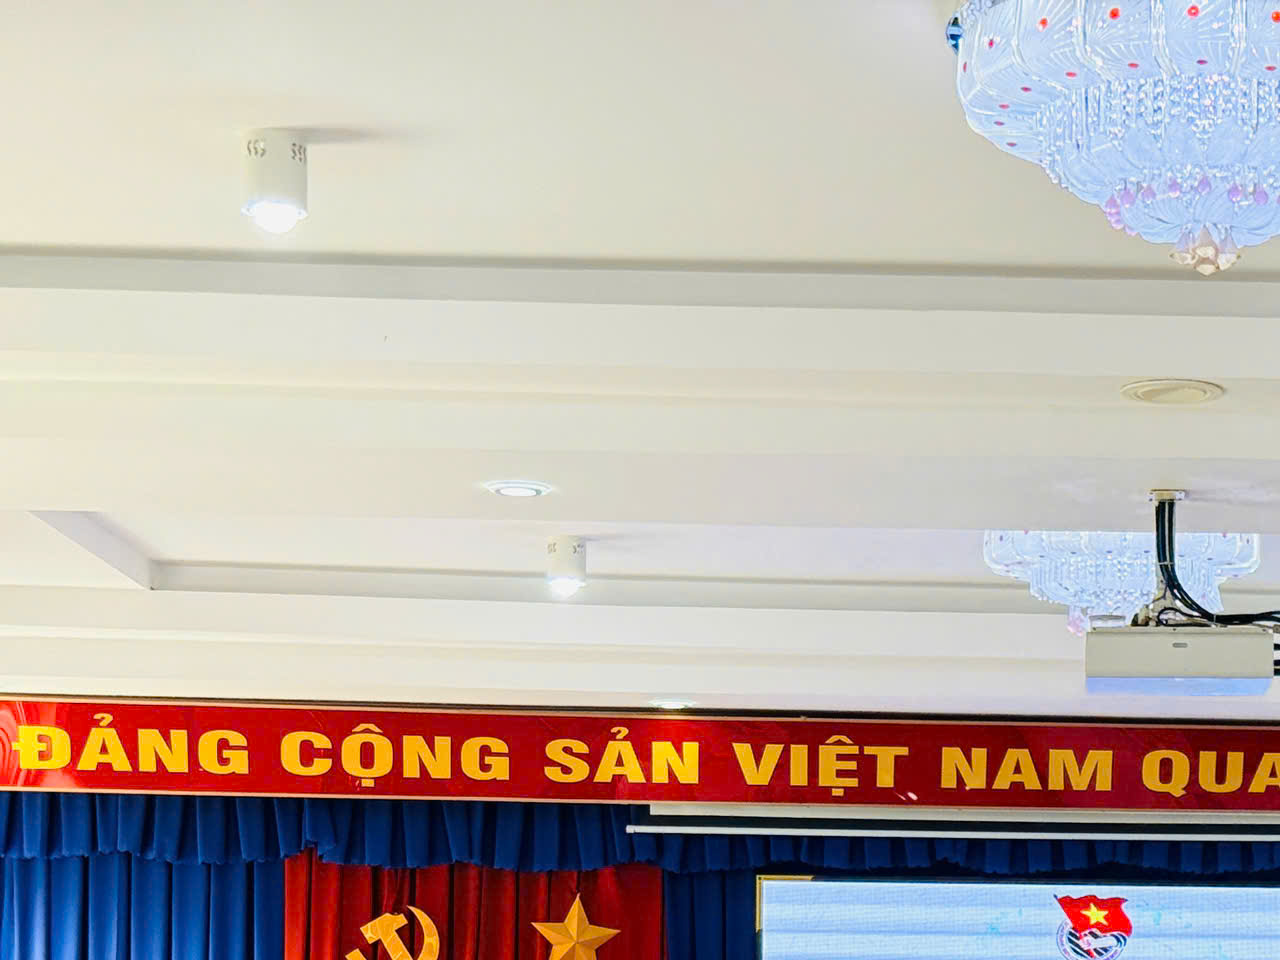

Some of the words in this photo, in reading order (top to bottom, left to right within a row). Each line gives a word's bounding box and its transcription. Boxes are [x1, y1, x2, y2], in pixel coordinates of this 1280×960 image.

[11, 714, 250, 775] ĐẢNG
[280, 723, 511, 787] CỘNG
[543, 727, 700, 785] SẢN
[731, 735, 909, 797] VIỆT
[940, 747, 1113, 791] NAM
